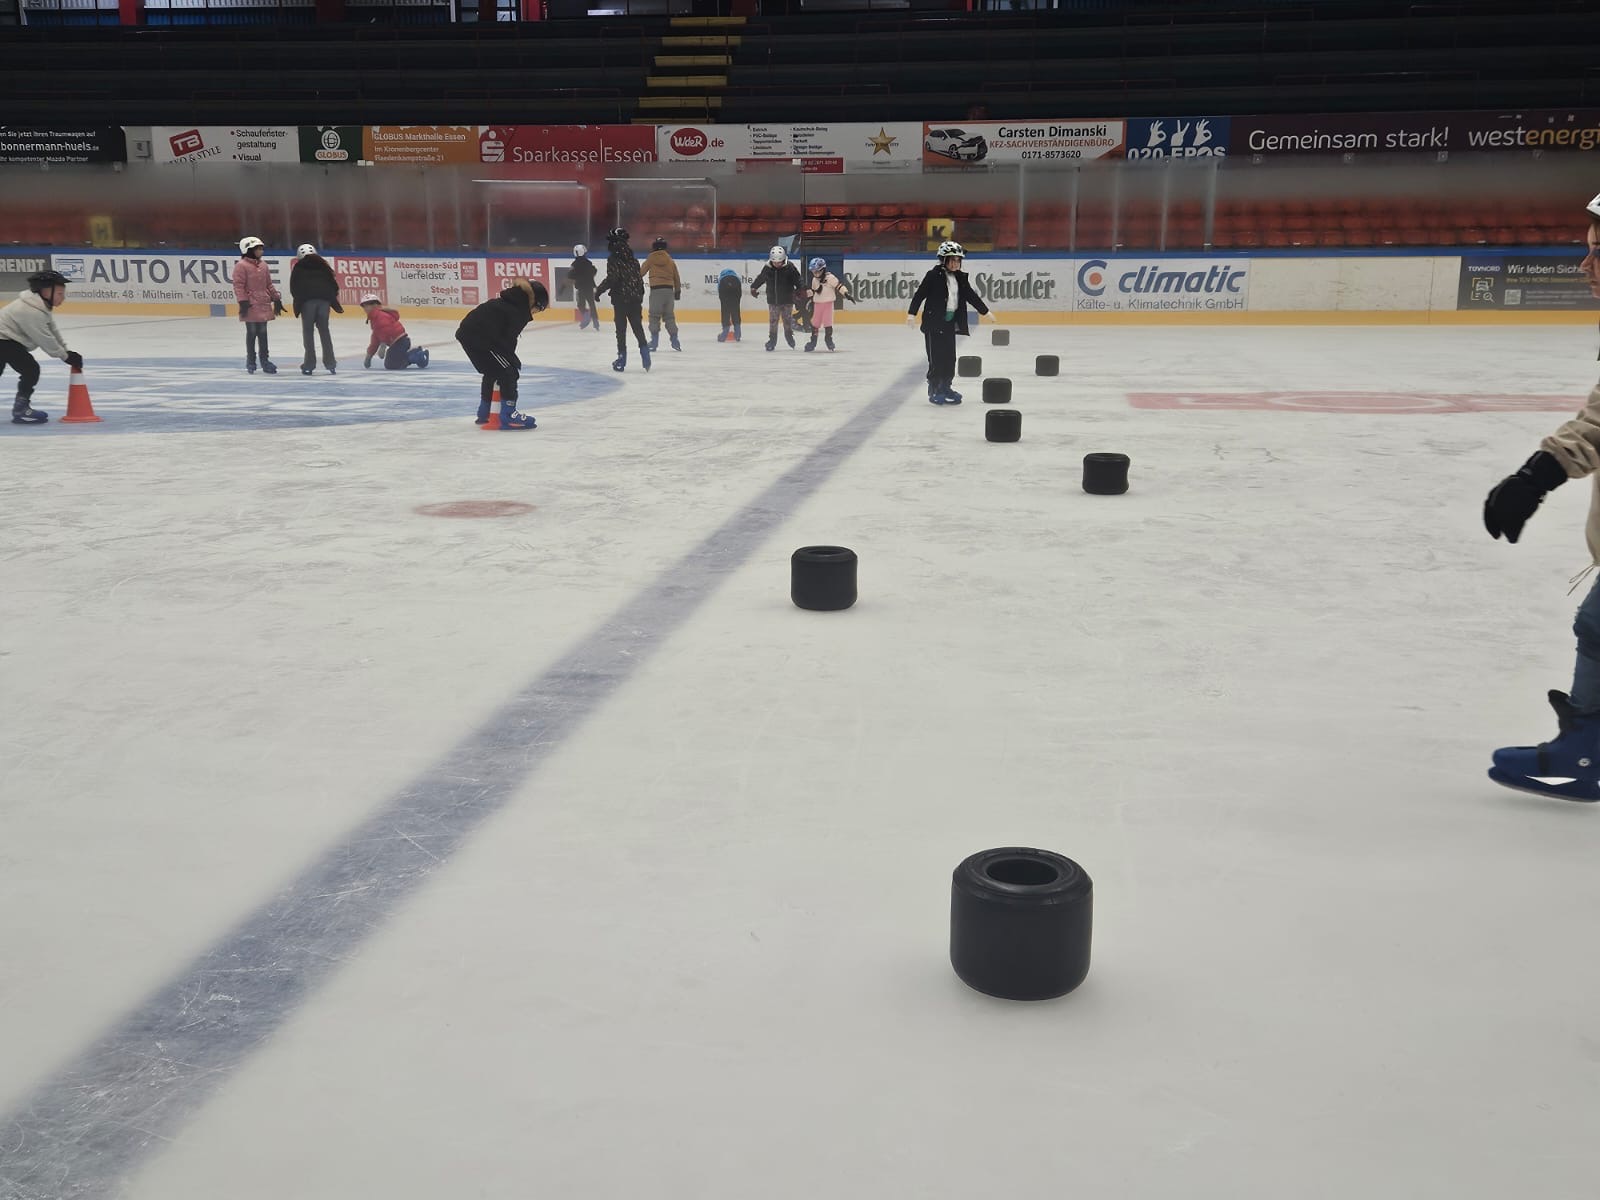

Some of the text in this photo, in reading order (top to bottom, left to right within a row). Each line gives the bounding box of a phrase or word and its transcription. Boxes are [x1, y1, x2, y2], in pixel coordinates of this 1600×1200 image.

[999, 124, 1107, 138] Carsten Dimanski
[1249, 126, 1449, 150] Gemeinsam stark!
[237, 141, 277, 150] gestaltung
[196, 145, 221, 160] STYLE
[238, 153, 262, 161] Visual
[317, 151, 347, 160] GLOBUS
[513, 146, 652, 163] Sparkasse Essen
[1021, 150, 1081, 159] 0171-8573620
[337, 259, 385, 275] REWE
[393, 261, 458, 269] Altenessen-Süd
[494, 262, 543, 277] REWE
[1507, 264, 1524, 274] Wir
[1526, 264, 1555, 274] leben
[90, 259, 281, 284] AUTO KRUE
[454, 271, 460, 280] 3
[345, 275, 379, 293] GROB
[975, 271, 1056, 300] Stauder
[1118, 265, 1246, 294] climatic
[66, 289, 120, 299] umboldtstr.
[122, 290, 135, 299] 48
[143, 289, 184, 299] Mülheim
[191, 290, 209, 299] Tel.
[400, 296, 460, 306] Isinger Tor 14
[1077, 299, 1244, 310] Kälte- u. Klimatechnik GmbH
